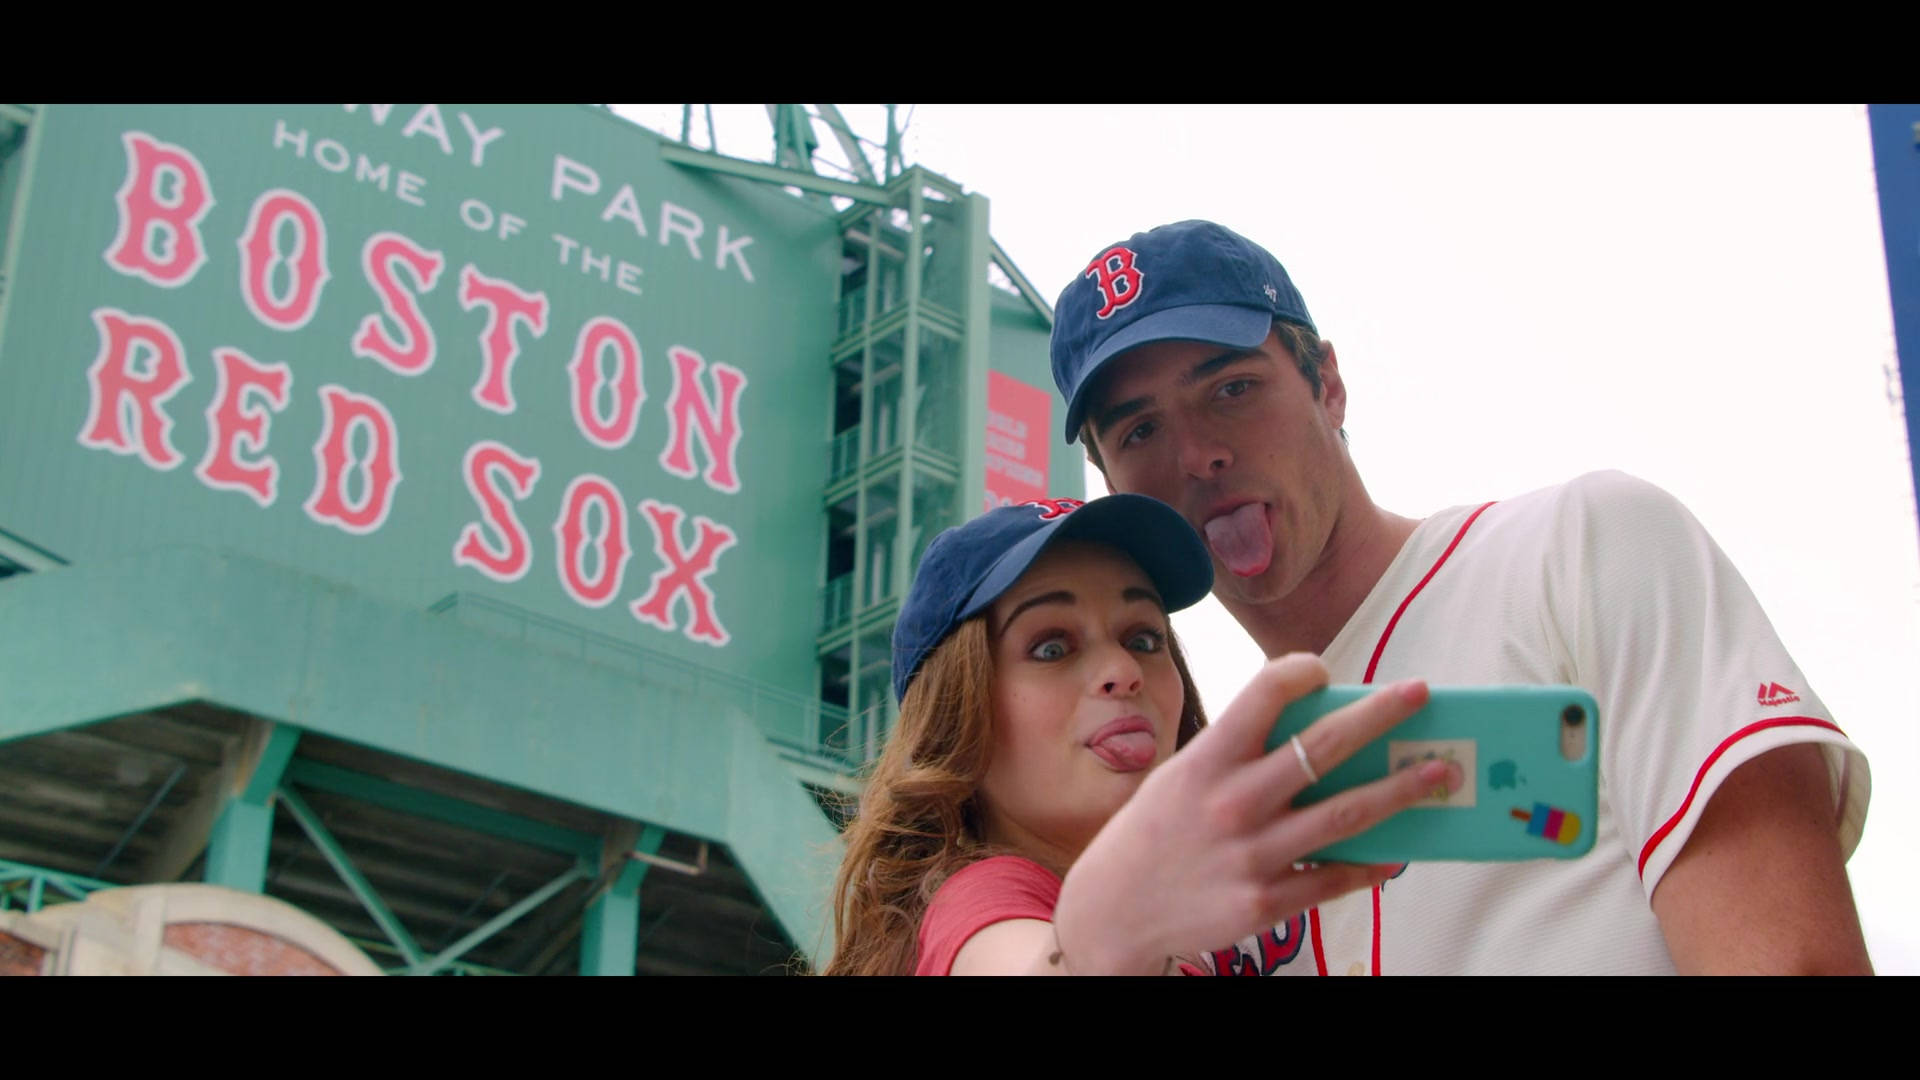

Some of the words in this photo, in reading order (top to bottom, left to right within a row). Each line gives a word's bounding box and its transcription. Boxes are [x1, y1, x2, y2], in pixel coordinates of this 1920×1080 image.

[273, 119, 427, 207] HOME
[459, 199, 528, 241] OF
[552, 233, 644, 296] THE
[552, 154, 755, 283] PARK
[1085, 246, 1145, 320] B
[104, 131, 747, 494] BOSTON
[77, 307, 404, 535] RED
[453, 440, 737, 647] SOX
[1758, 695, 1801, 708] Majestic
